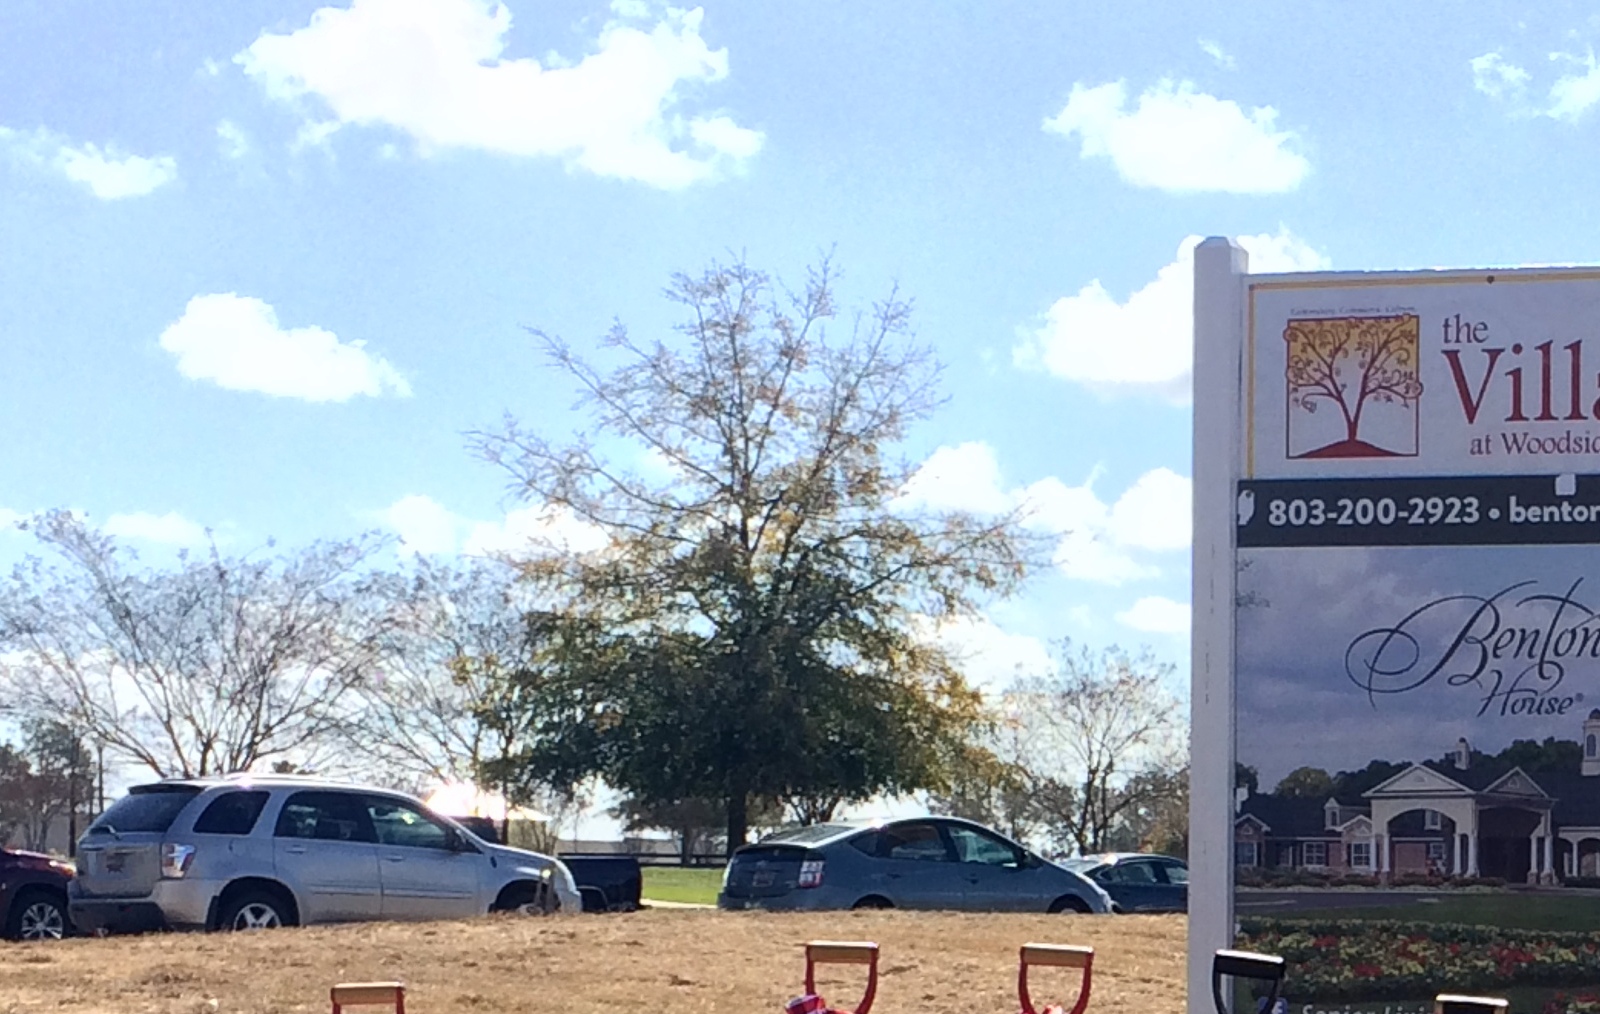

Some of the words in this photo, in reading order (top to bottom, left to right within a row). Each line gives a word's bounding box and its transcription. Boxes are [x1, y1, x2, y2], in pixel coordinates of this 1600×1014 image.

[1442, 313, 1489, 344] the
[1470, 434, 1492, 455] at
[1268, 497, 1480, 526] 803-200-2923
